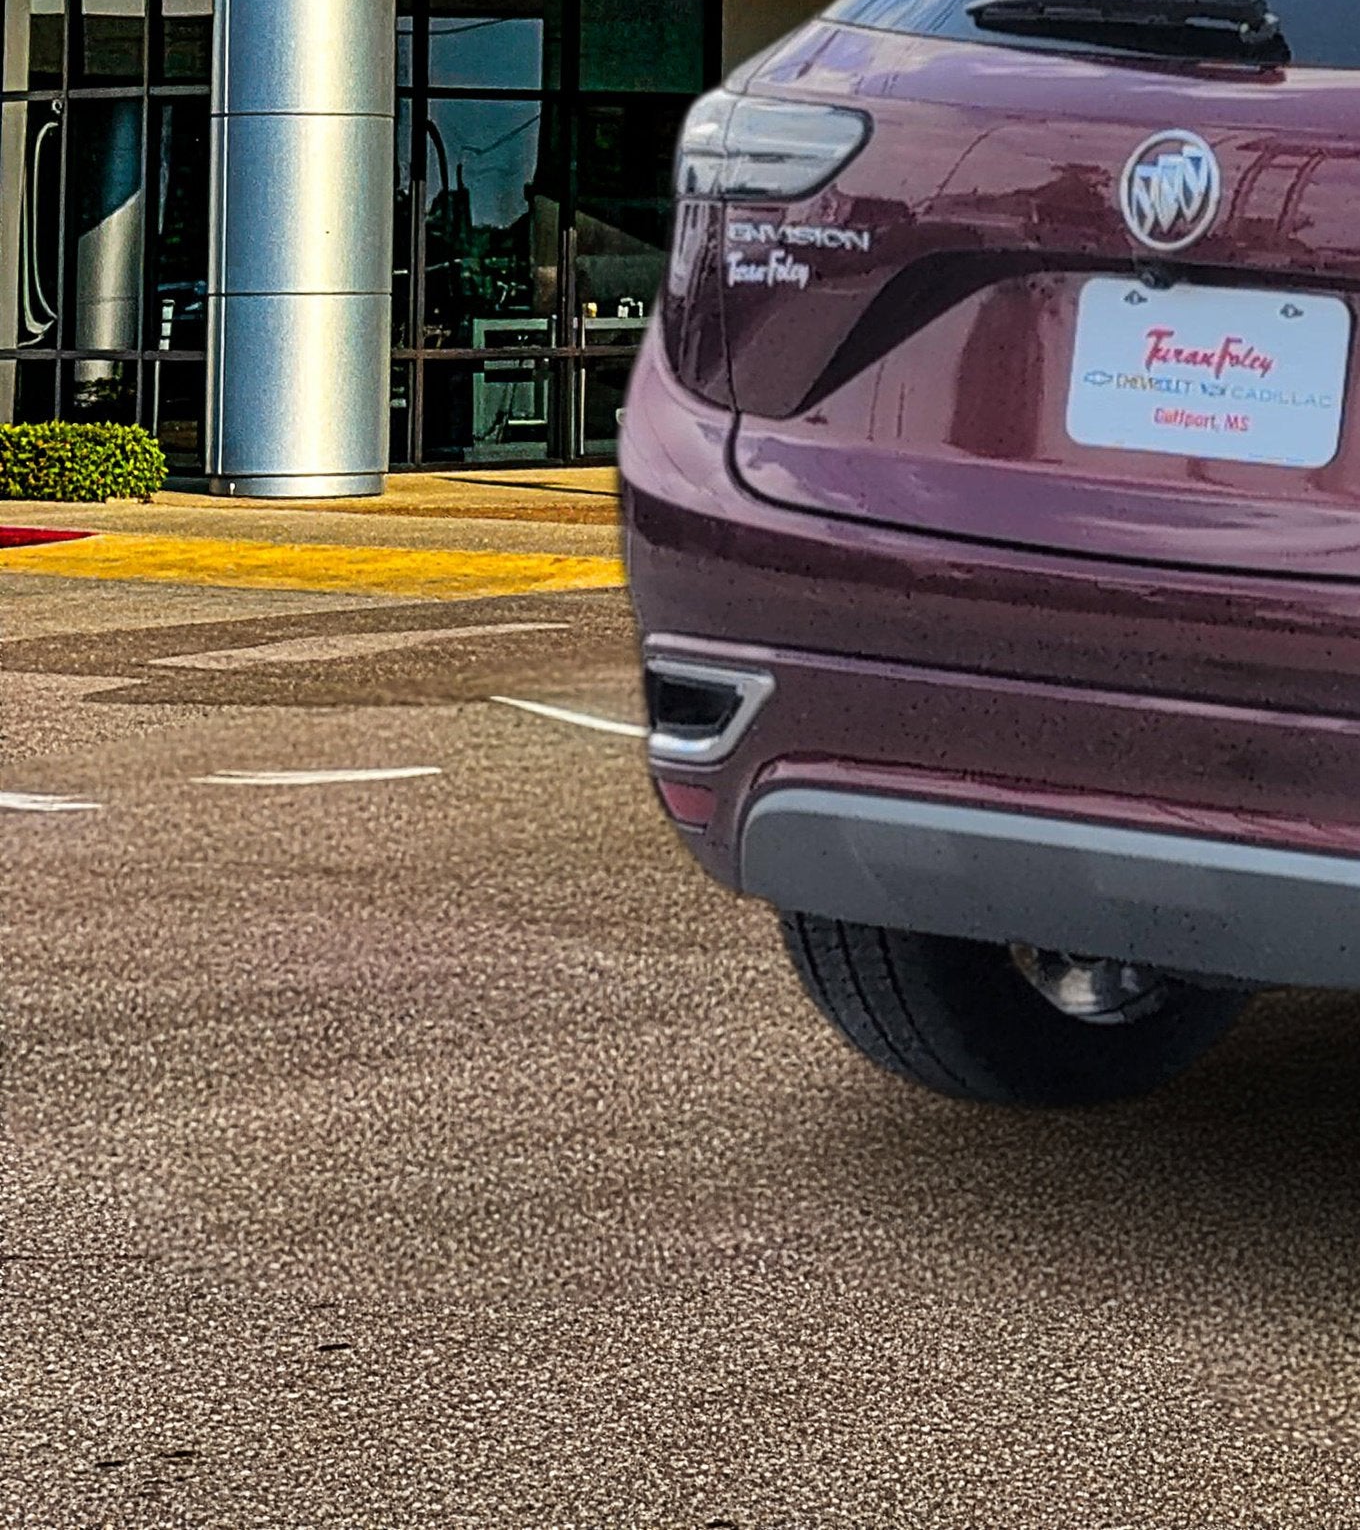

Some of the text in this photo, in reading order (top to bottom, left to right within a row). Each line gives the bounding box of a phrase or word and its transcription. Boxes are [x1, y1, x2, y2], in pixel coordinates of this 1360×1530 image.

[726, 222, 870, 252] ENVISION
[1230, 385, 1333, 409] CADILLAC
[1223, 413, 1250, 432] MS
